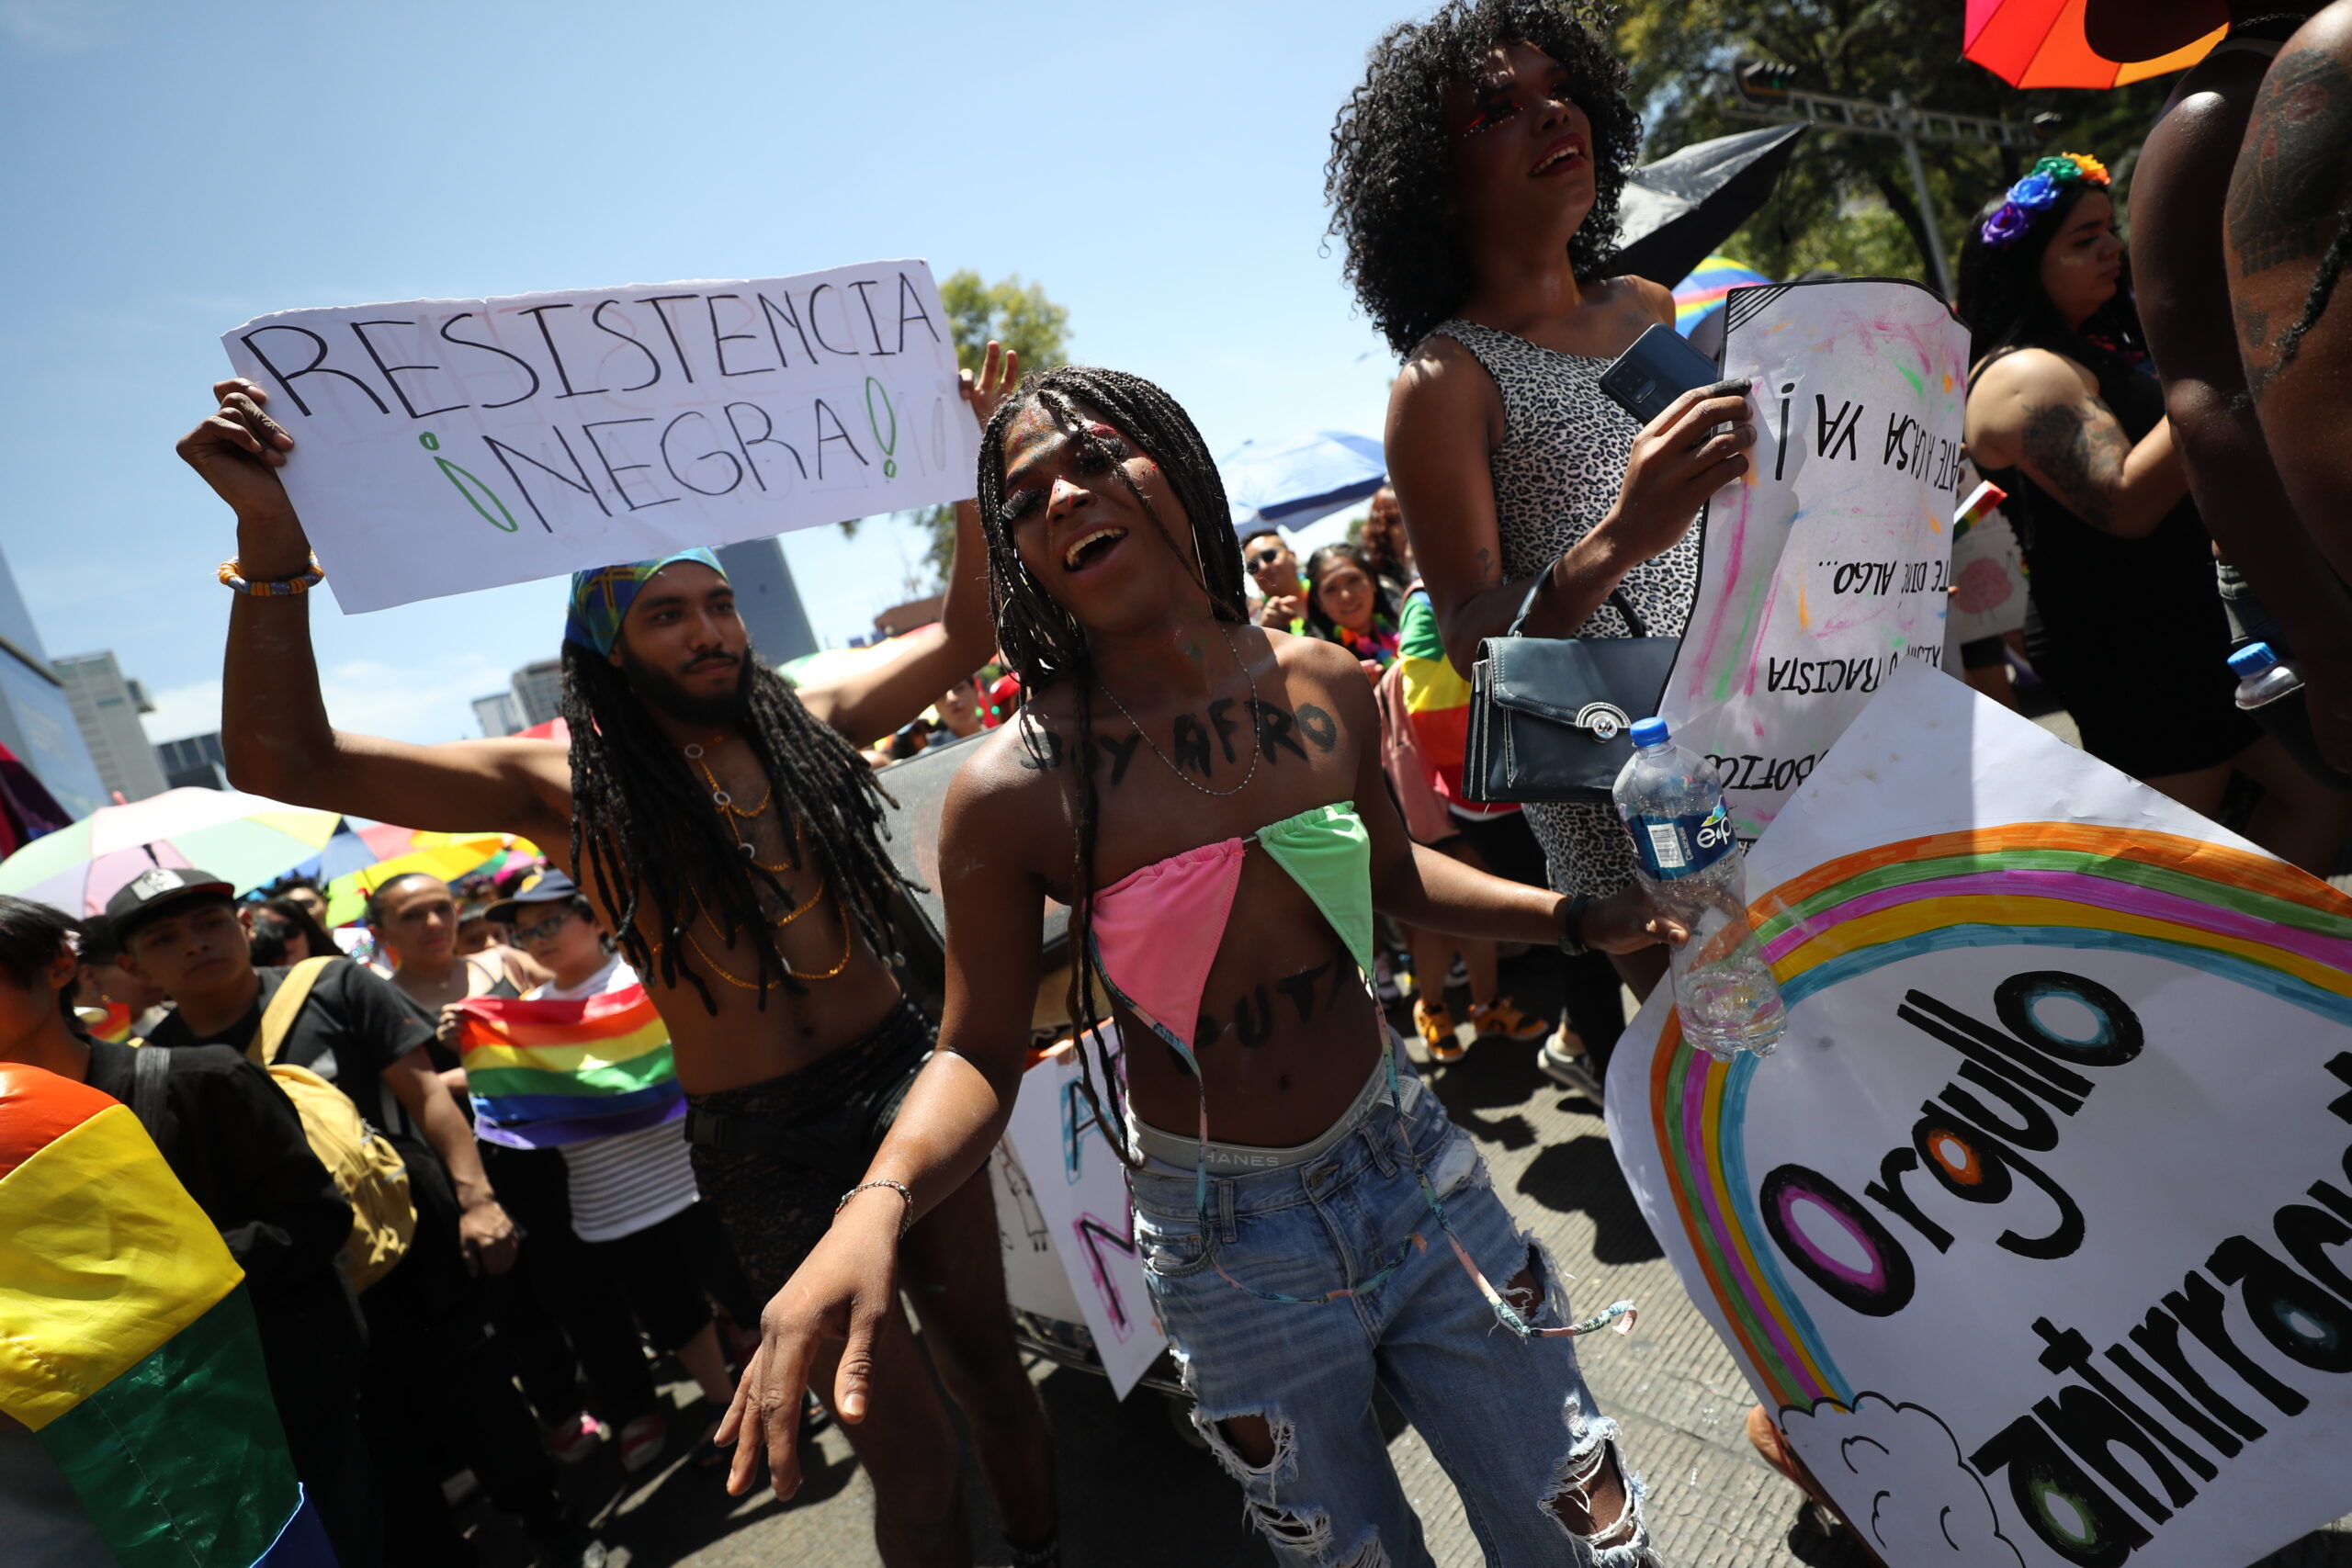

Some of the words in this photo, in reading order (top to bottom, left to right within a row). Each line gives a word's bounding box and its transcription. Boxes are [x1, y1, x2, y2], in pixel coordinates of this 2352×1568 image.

[240, 273, 941, 420] RESISTENCIA
[1767, 656, 1883, 695] RACISTA
[1172, 697, 1338, 778] AFRO
[1205, 1152, 1280, 1168] HANES
[1759, 970, 2145, 1317] Orgullo
